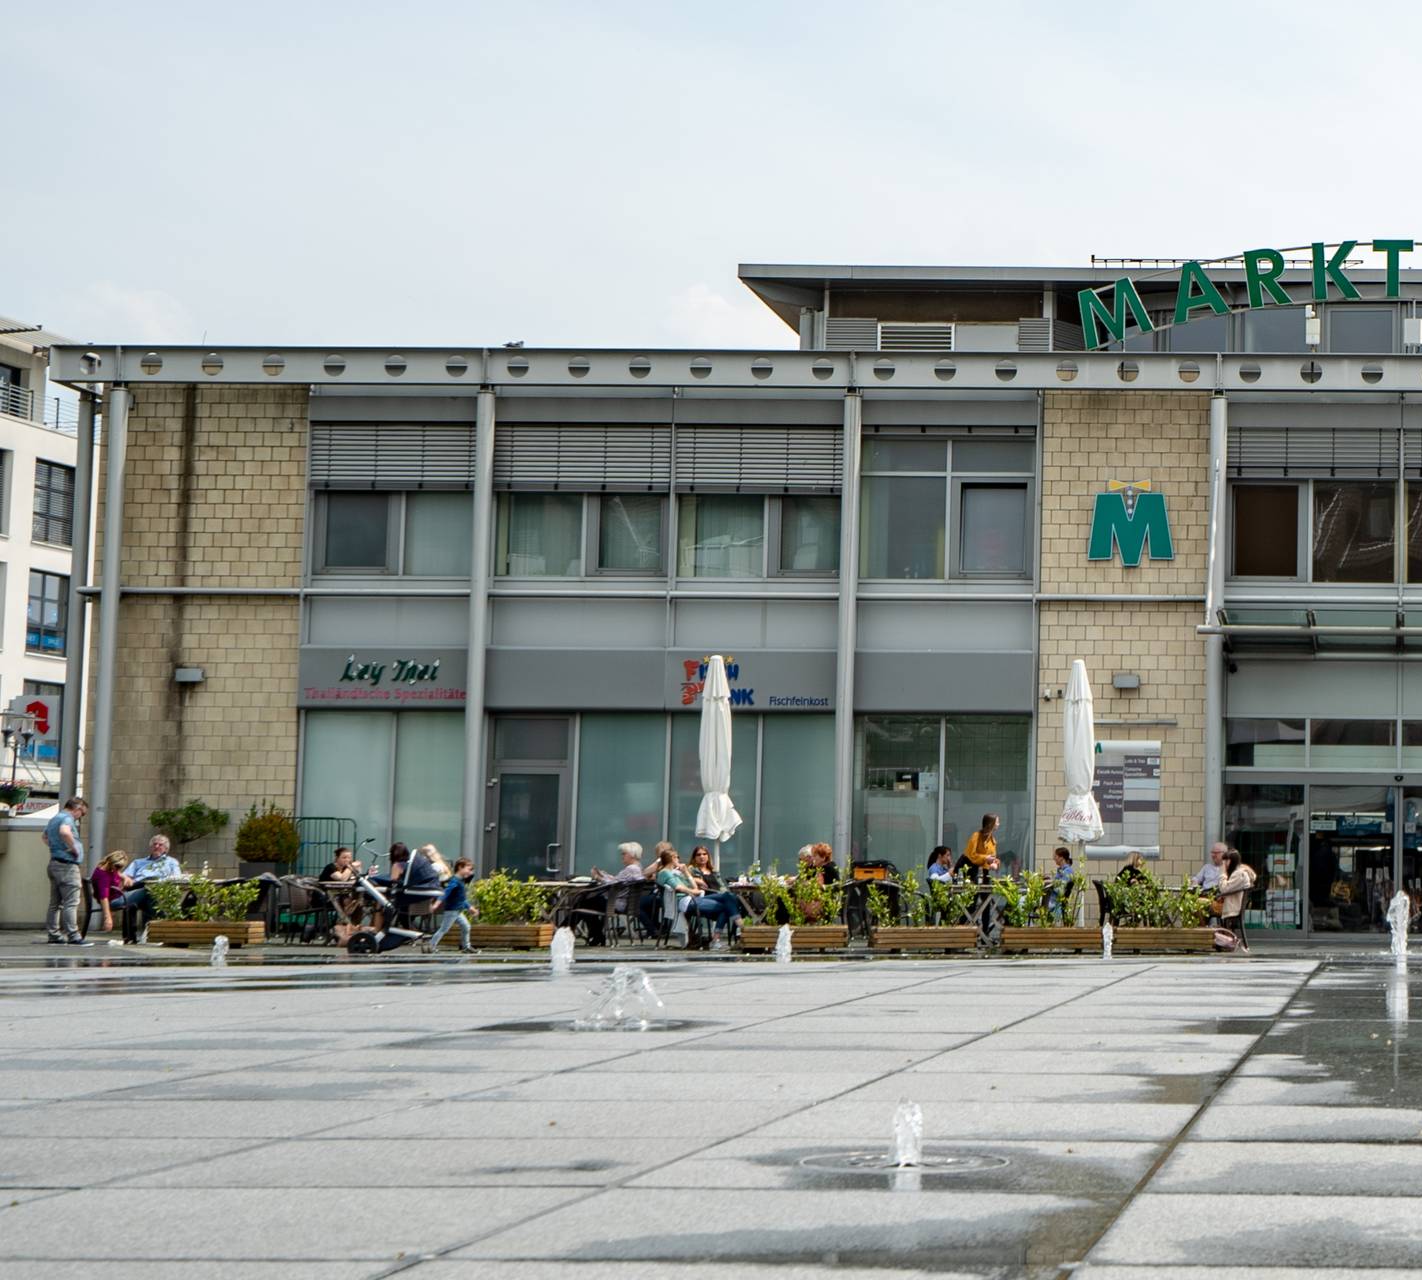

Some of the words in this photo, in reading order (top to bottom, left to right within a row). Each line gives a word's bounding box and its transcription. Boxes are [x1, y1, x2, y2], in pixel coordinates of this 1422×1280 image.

[1087, 492, 1174, 567] M
[394, 688, 467, 703] Spezialitäte
[769, 696, 829, 706] Fischfeinkost
